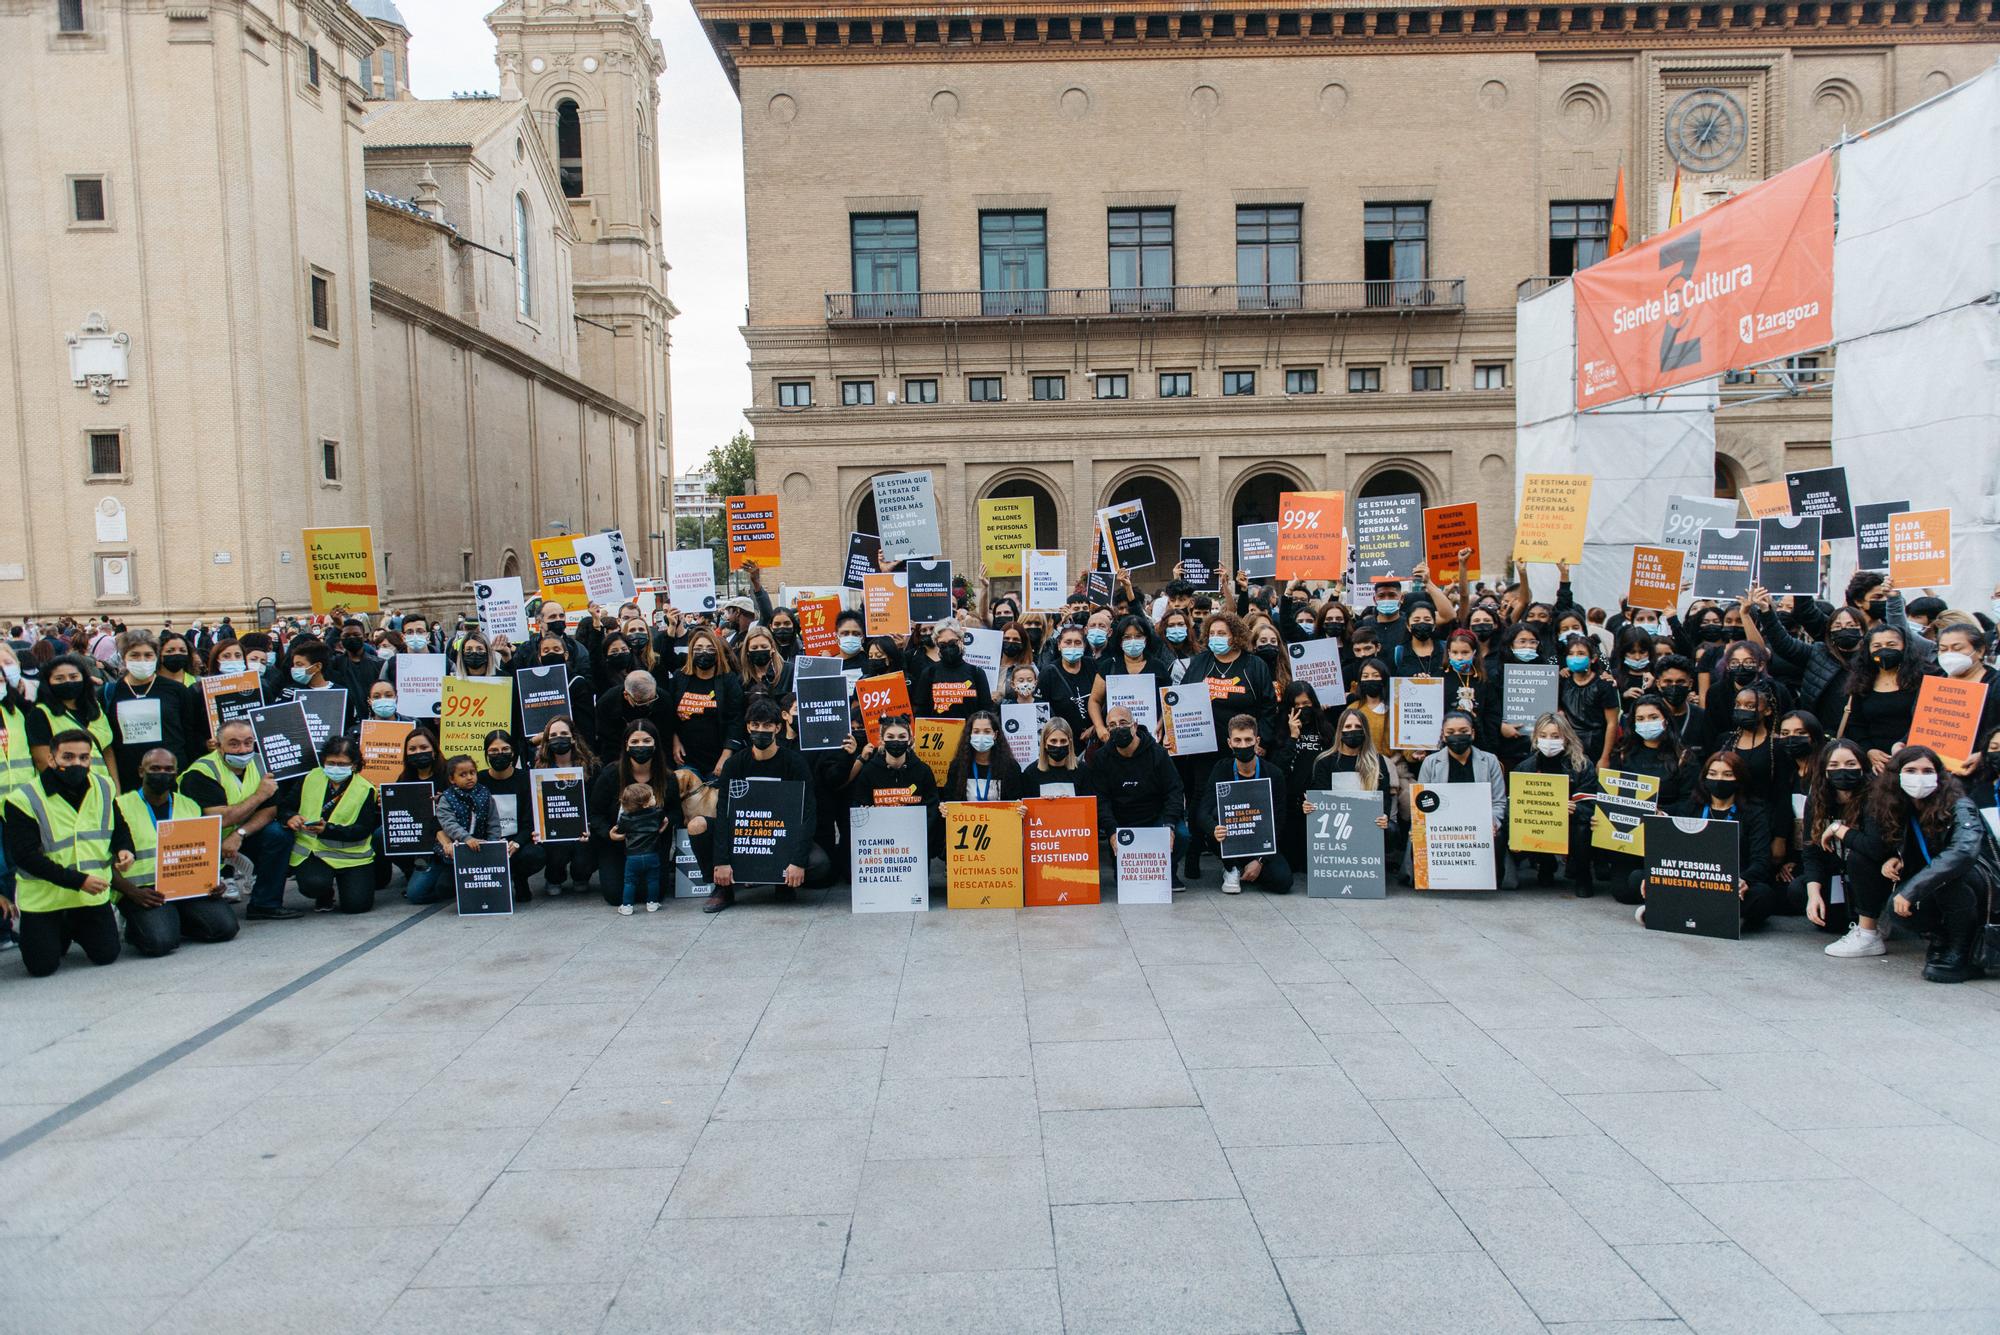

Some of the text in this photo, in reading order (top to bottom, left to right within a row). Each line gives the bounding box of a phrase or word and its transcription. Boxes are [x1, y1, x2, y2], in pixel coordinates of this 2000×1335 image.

[1614, 264, 1752, 335] Siente la Cultura
[1756, 301, 1818, 332] Zaragoza
[1370, 500, 1398, 508] ESTIMA
[732, 512, 763, 520] MILLONES
[1359, 517, 1399, 526] PERSONAS
[1895, 521, 1920, 531] CADA
[1359, 523, 1408, 534] GENERA MÁS
[1895, 531, 1925, 541] DÍA SE
[1360, 542, 1398, 550] MILLONES
[1895, 540, 1932, 552] VENDEN
[312, 552, 367, 560] ESCLAVITUD
[1895, 549, 1945, 562] PERSONAS
[1372, 558, 1390, 566] AÑO.
[315, 572, 367, 580] EXISTIENDO
[445, 696, 488, 717] 99%
[474, 719, 508, 727] VÍCTIMAS
[1618, 779, 1639, 788] TRATA
[1599, 794, 1655, 809] SERES HUMANOS
[1313, 802, 1337, 811] SÓLO
[952, 814, 977, 822] SÓLO
[1030, 818, 1042, 826] LA
[1611, 814, 1638, 824] OCURRE
[754, 828, 772, 836] AÑOS
[1030, 829, 1090, 838] ESCLAVITUD
[734, 837, 776, 846] ESTÁ SIENDO
[868, 838, 894, 846] CAMINO
[1031, 842, 1059, 850] SIGUE
[883, 846, 899, 854] NIÑO
[1329, 843, 1347, 851] LAS
[865, 856, 883, 864] AÑOS
[1031, 853, 1088, 862] EXISTIENDO
[1314, 855, 1380, 865] VÍCTIMAS SON
[1661, 859, 1721, 872] HAY PERSONAS
[953, 866, 1018, 875] VÍCTIMAS SON
[1314, 870, 1378, 878] RESCATADAS.
[1651, 867, 1732, 882] SIENDO EXPLOTADAS
[880, 875, 902, 883] CALLE.
[1651, 876, 1733, 891] EN NUESTRA CIUDAD.
[953, 881, 1016, 889] RESCATADAS.
